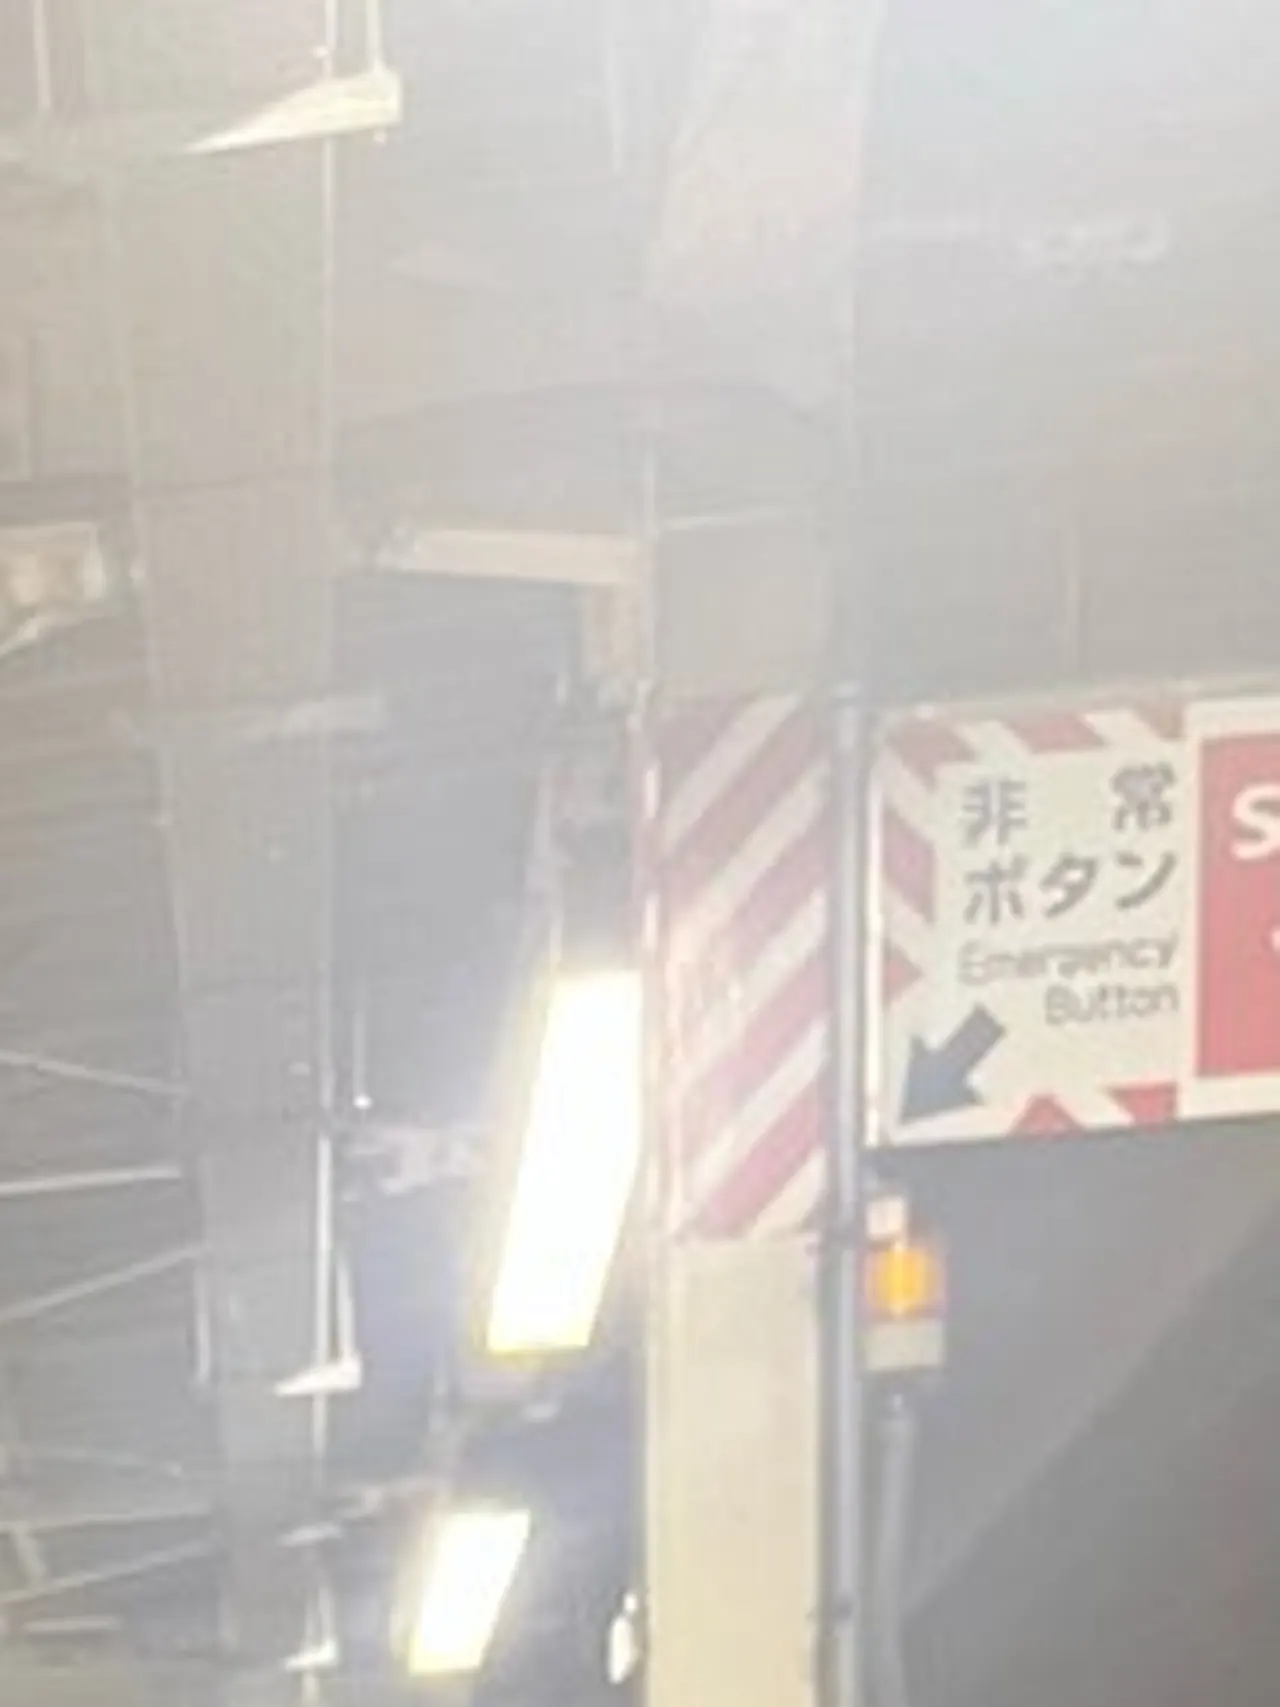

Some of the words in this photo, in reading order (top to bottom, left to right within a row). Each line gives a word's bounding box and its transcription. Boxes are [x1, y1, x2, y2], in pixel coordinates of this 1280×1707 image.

[964, 850, 1177, 923] ボタン
[1044, 984, 1178, 1026] Button
